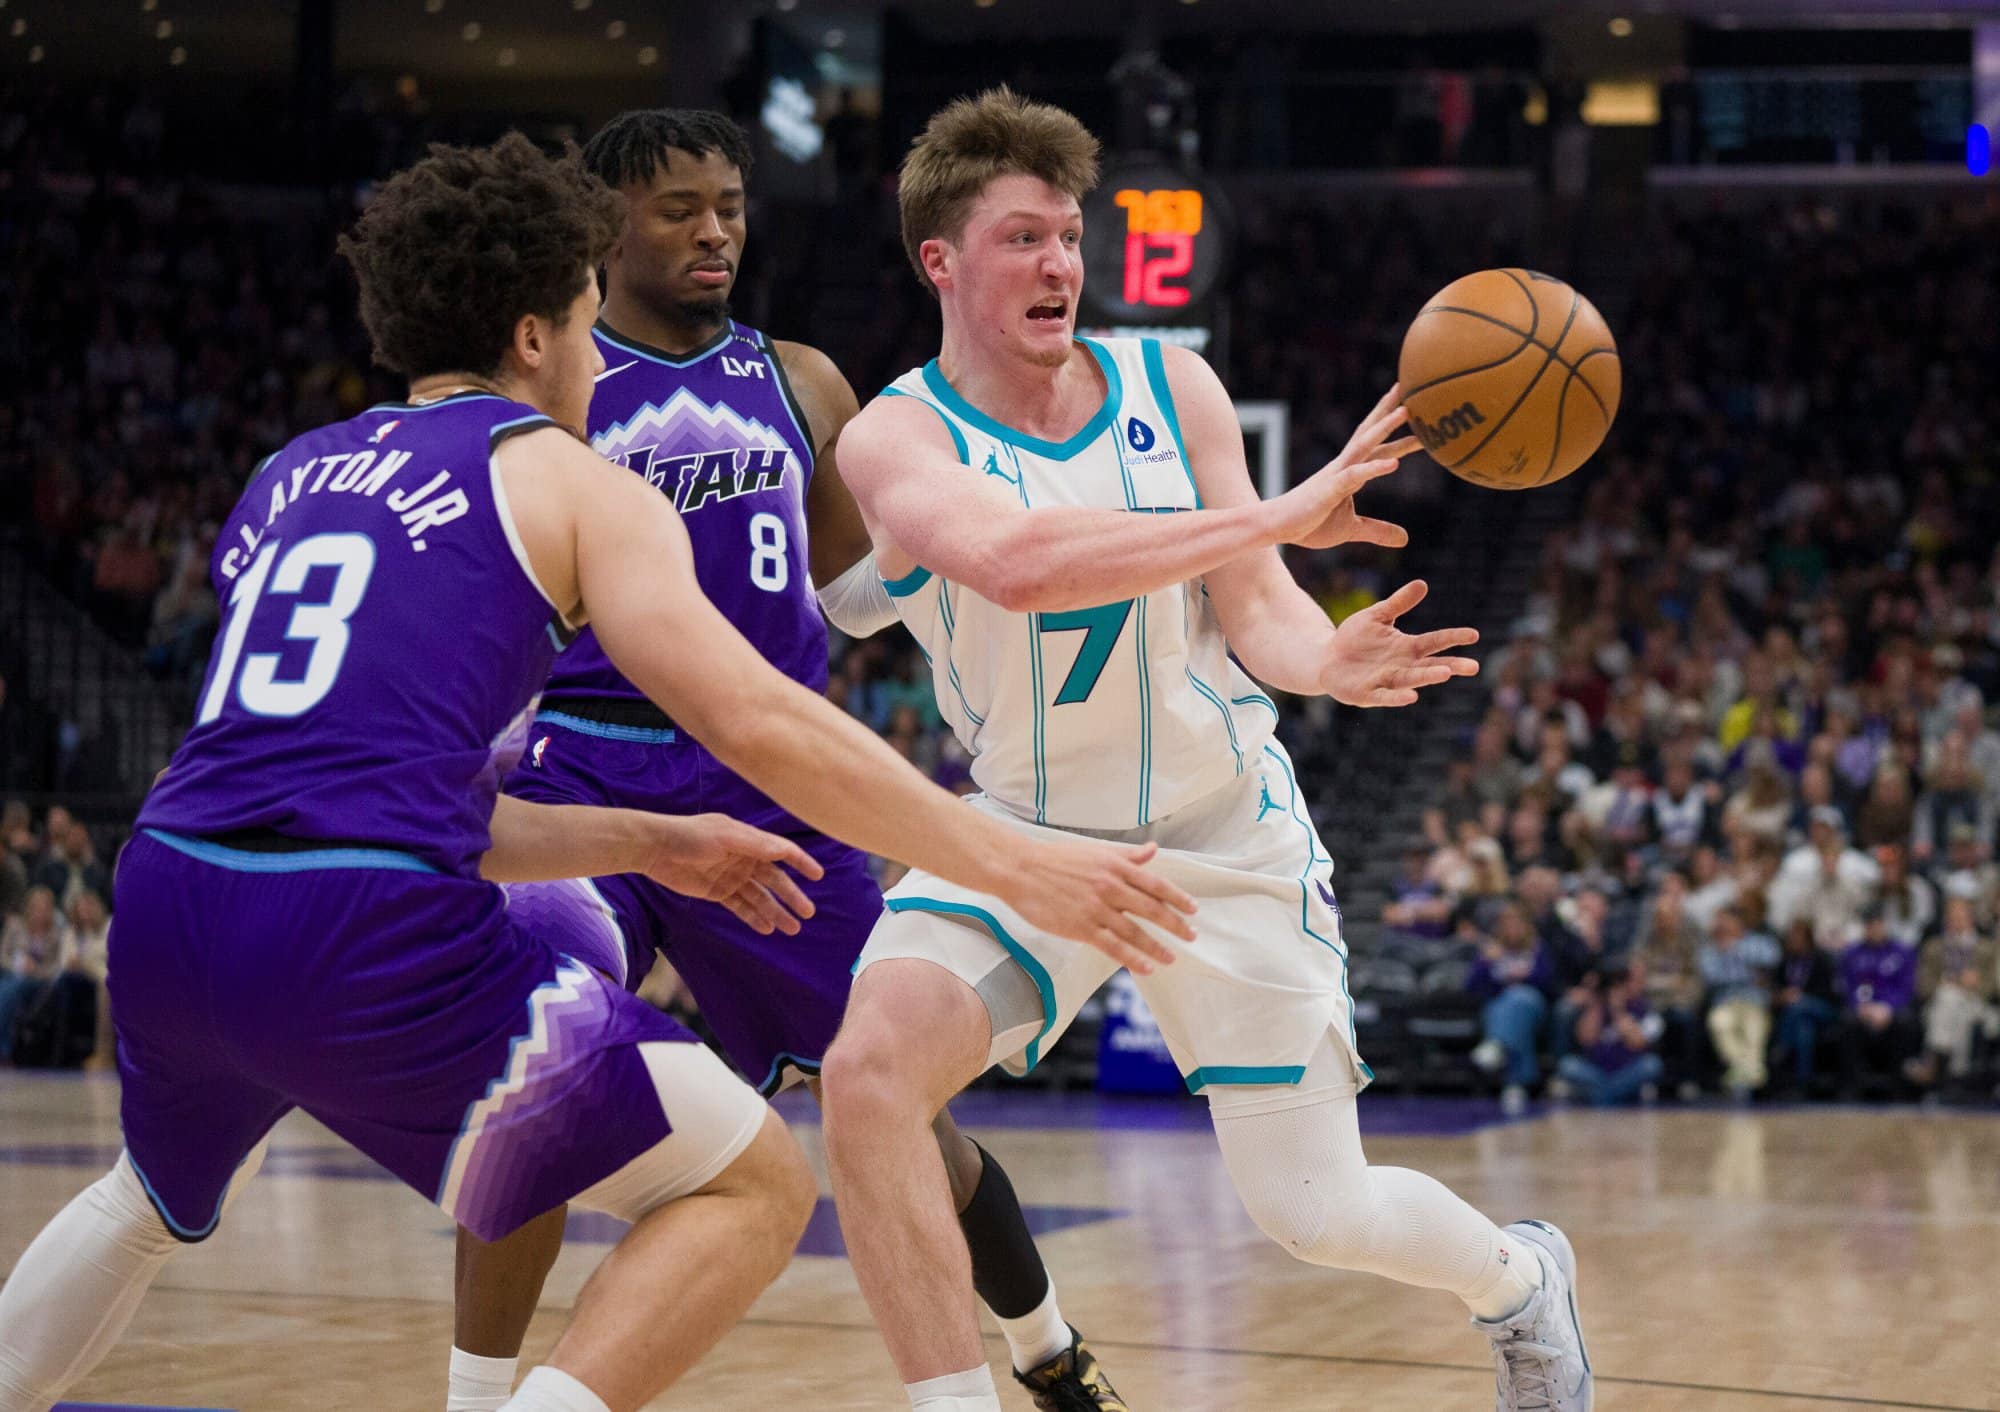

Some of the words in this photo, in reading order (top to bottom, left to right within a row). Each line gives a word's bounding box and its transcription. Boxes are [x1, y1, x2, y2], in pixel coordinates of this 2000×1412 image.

[1123, 231, 1195, 307] 12
[721, 355, 765, 379] LVT
[1143, 449, 1177, 464] Health
[386, 469, 470, 552] JR.
[749, 512, 788, 592] 8
[195, 531, 377, 728] 13
[1039, 597, 1136, 707] 7
